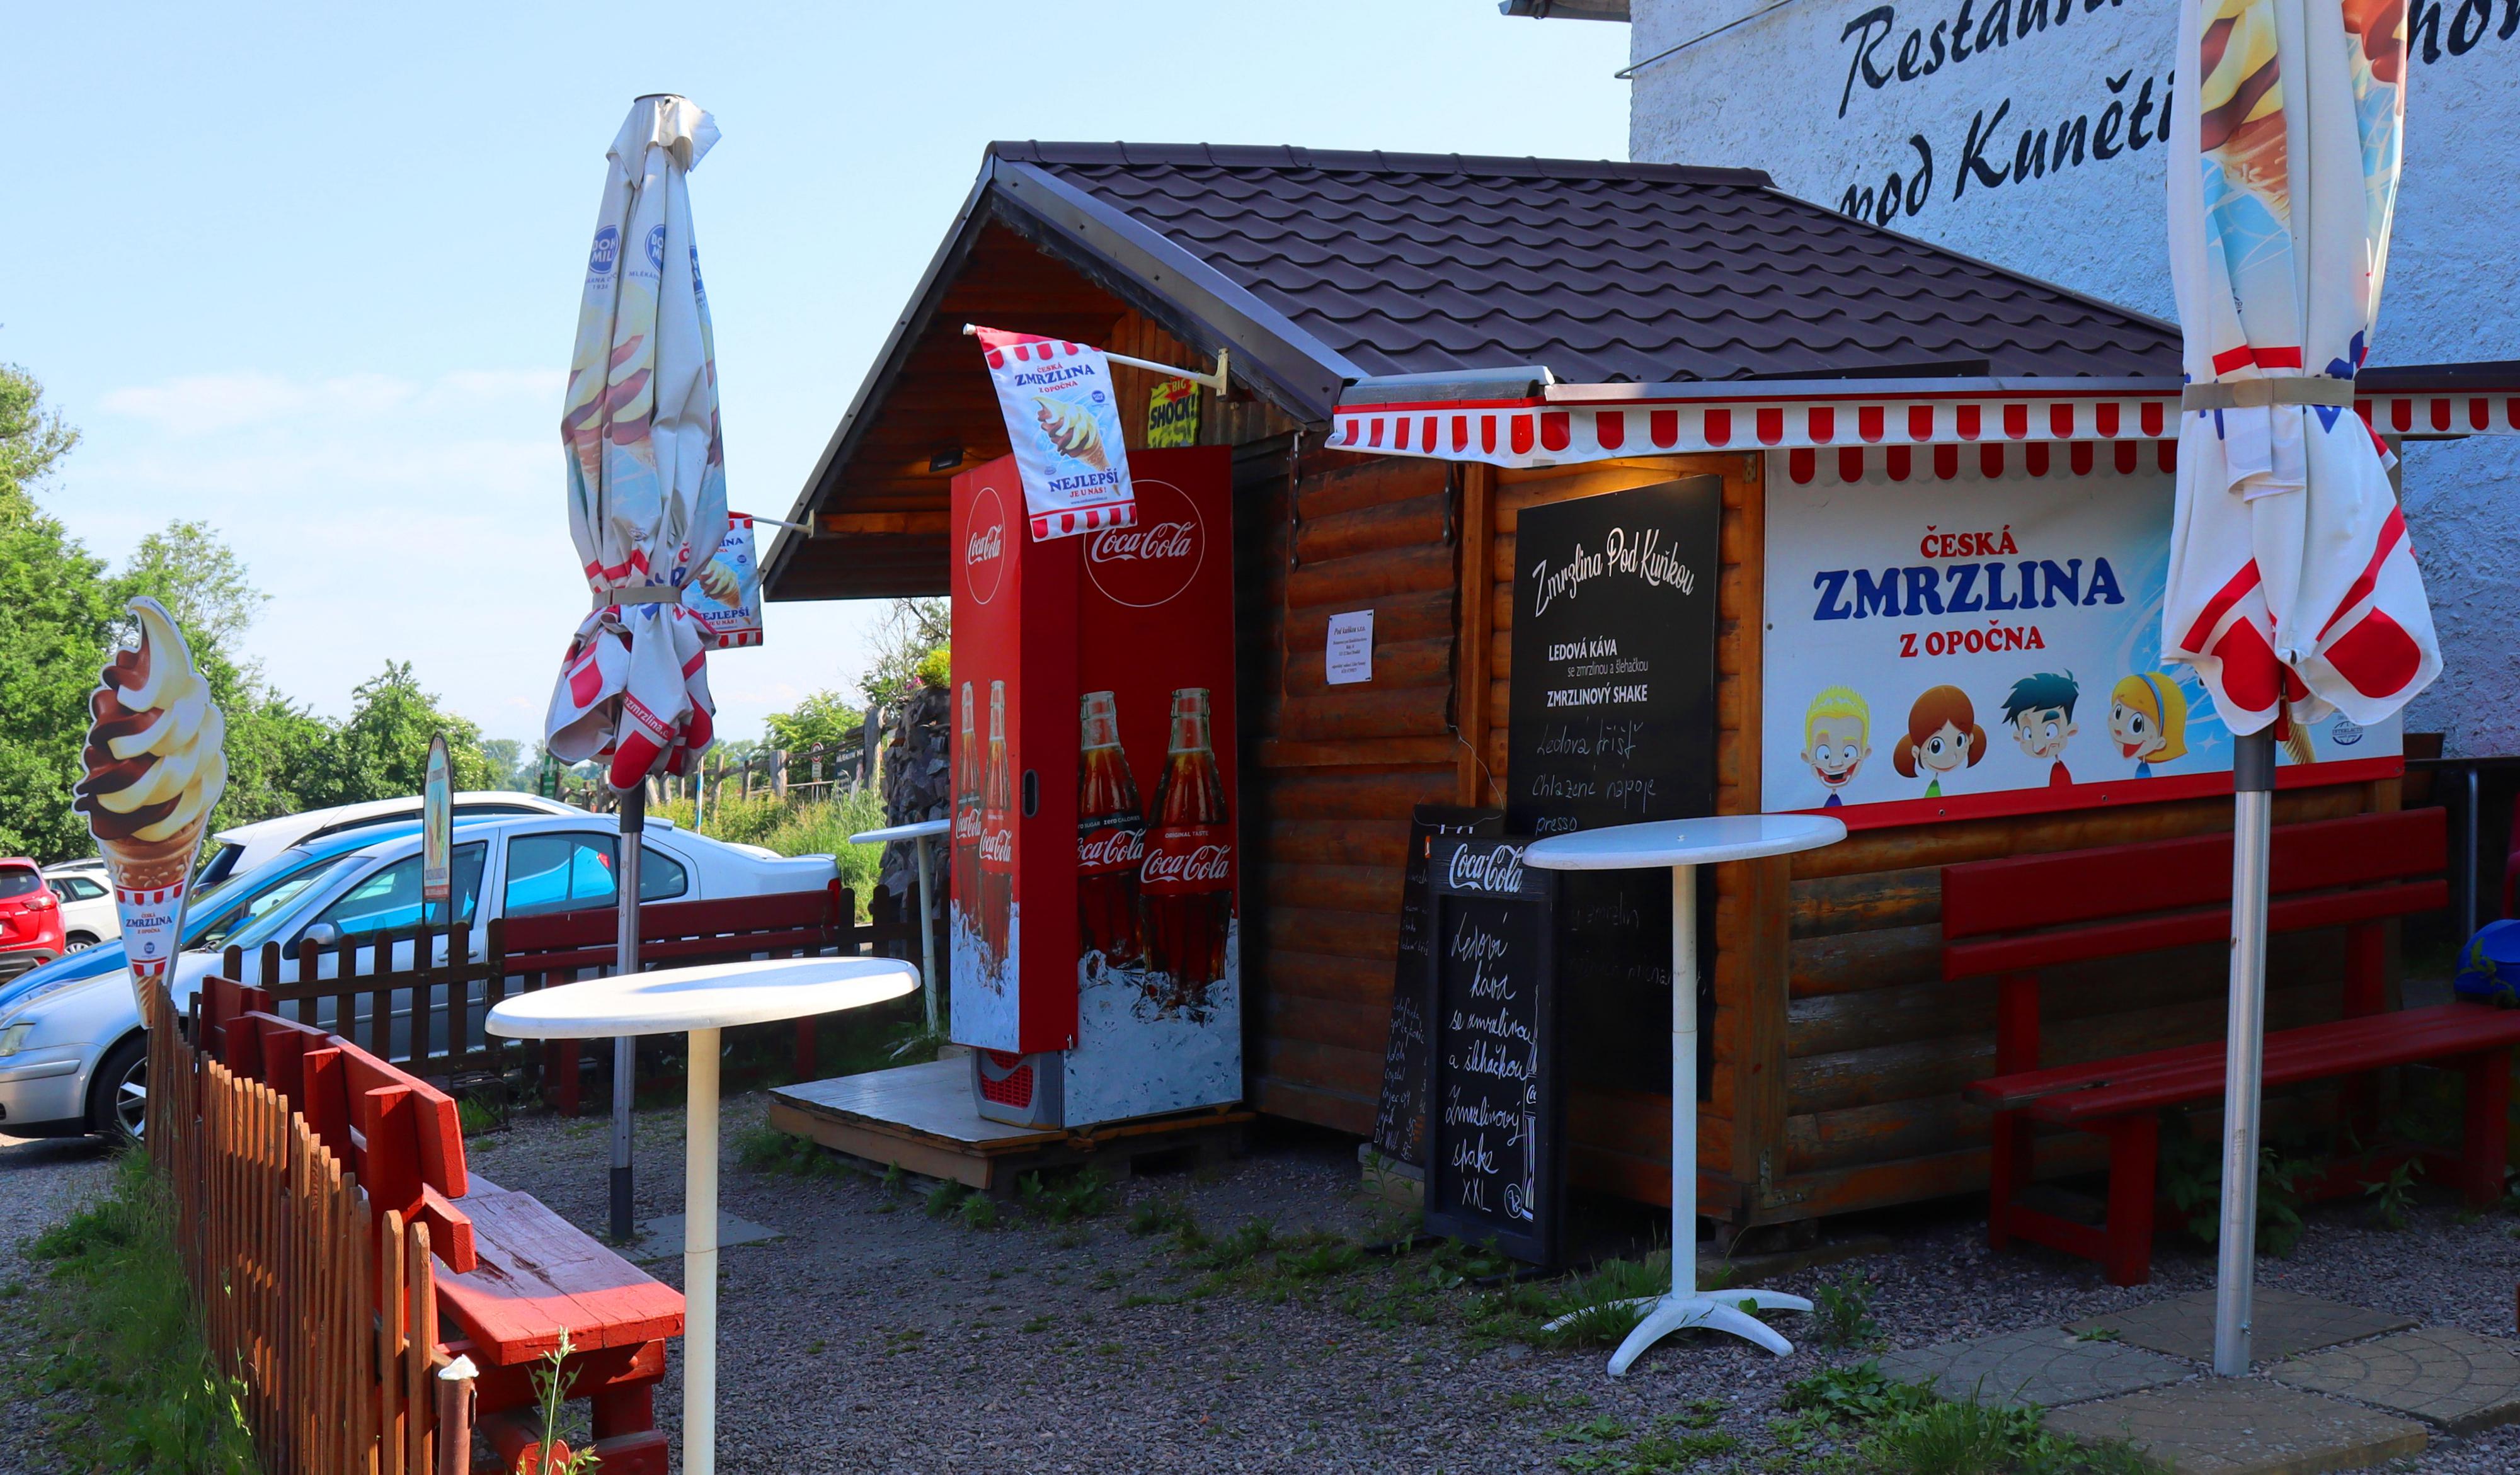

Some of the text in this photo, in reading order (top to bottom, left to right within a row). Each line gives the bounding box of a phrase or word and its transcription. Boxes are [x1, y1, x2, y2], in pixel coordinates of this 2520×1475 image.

[1952, 68, 2174, 202] Kuněti
[1015, 364, 1095, 386] ZMRZLINA
[1037, 362, 1063, 373] ČESKÁ
[1044, 380, 1078, 392] OPOČNA
[1172, 379, 1186, 392] BIG
[1150, 393, 1196, 430] SHOCK!
[1048, 468, 1118, 492] NEJLEPŠÍ
[968, 524, 1003, 565] Coca-Cola
[1091, 521, 1197, 562] Coca-Cola
[1920, 525, 2019, 559] ČESKÁ
[1532, 527, 1694, 618] Zmrzlina Pod Kuňkou
[1813, 557, 2126, 620] ZMRZLINA
[702, 606, 750, 621] EJLEPŠÍ
[1549, 635, 1618, 661] LEDOVÁ KÁVA
[1899, 620, 2045, 658] Z OPOČNA
[1567, 658, 1649, 678] se zmrzlinou a šlehačkou
[1547, 682, 1647, 707] ZMRZLINOVÝ SHAKE
[956, 807, 981, 840] Coca-Cola
[1084, 821, 1101, 829] SUGAR
[1104, 817, 1117, 826] zero
[980, 828, 1012, 862] Coca-Cola
[1078, 828, 1147, 867] oca-Cola
[1140, 845, 1232, 884] Coca-Cola
[1449, 843, 1523, 893] Coca-Cola
[125, 916, 172, 928] ZMRZLINA
[1462, 1178, 1492, 1212] XXL
